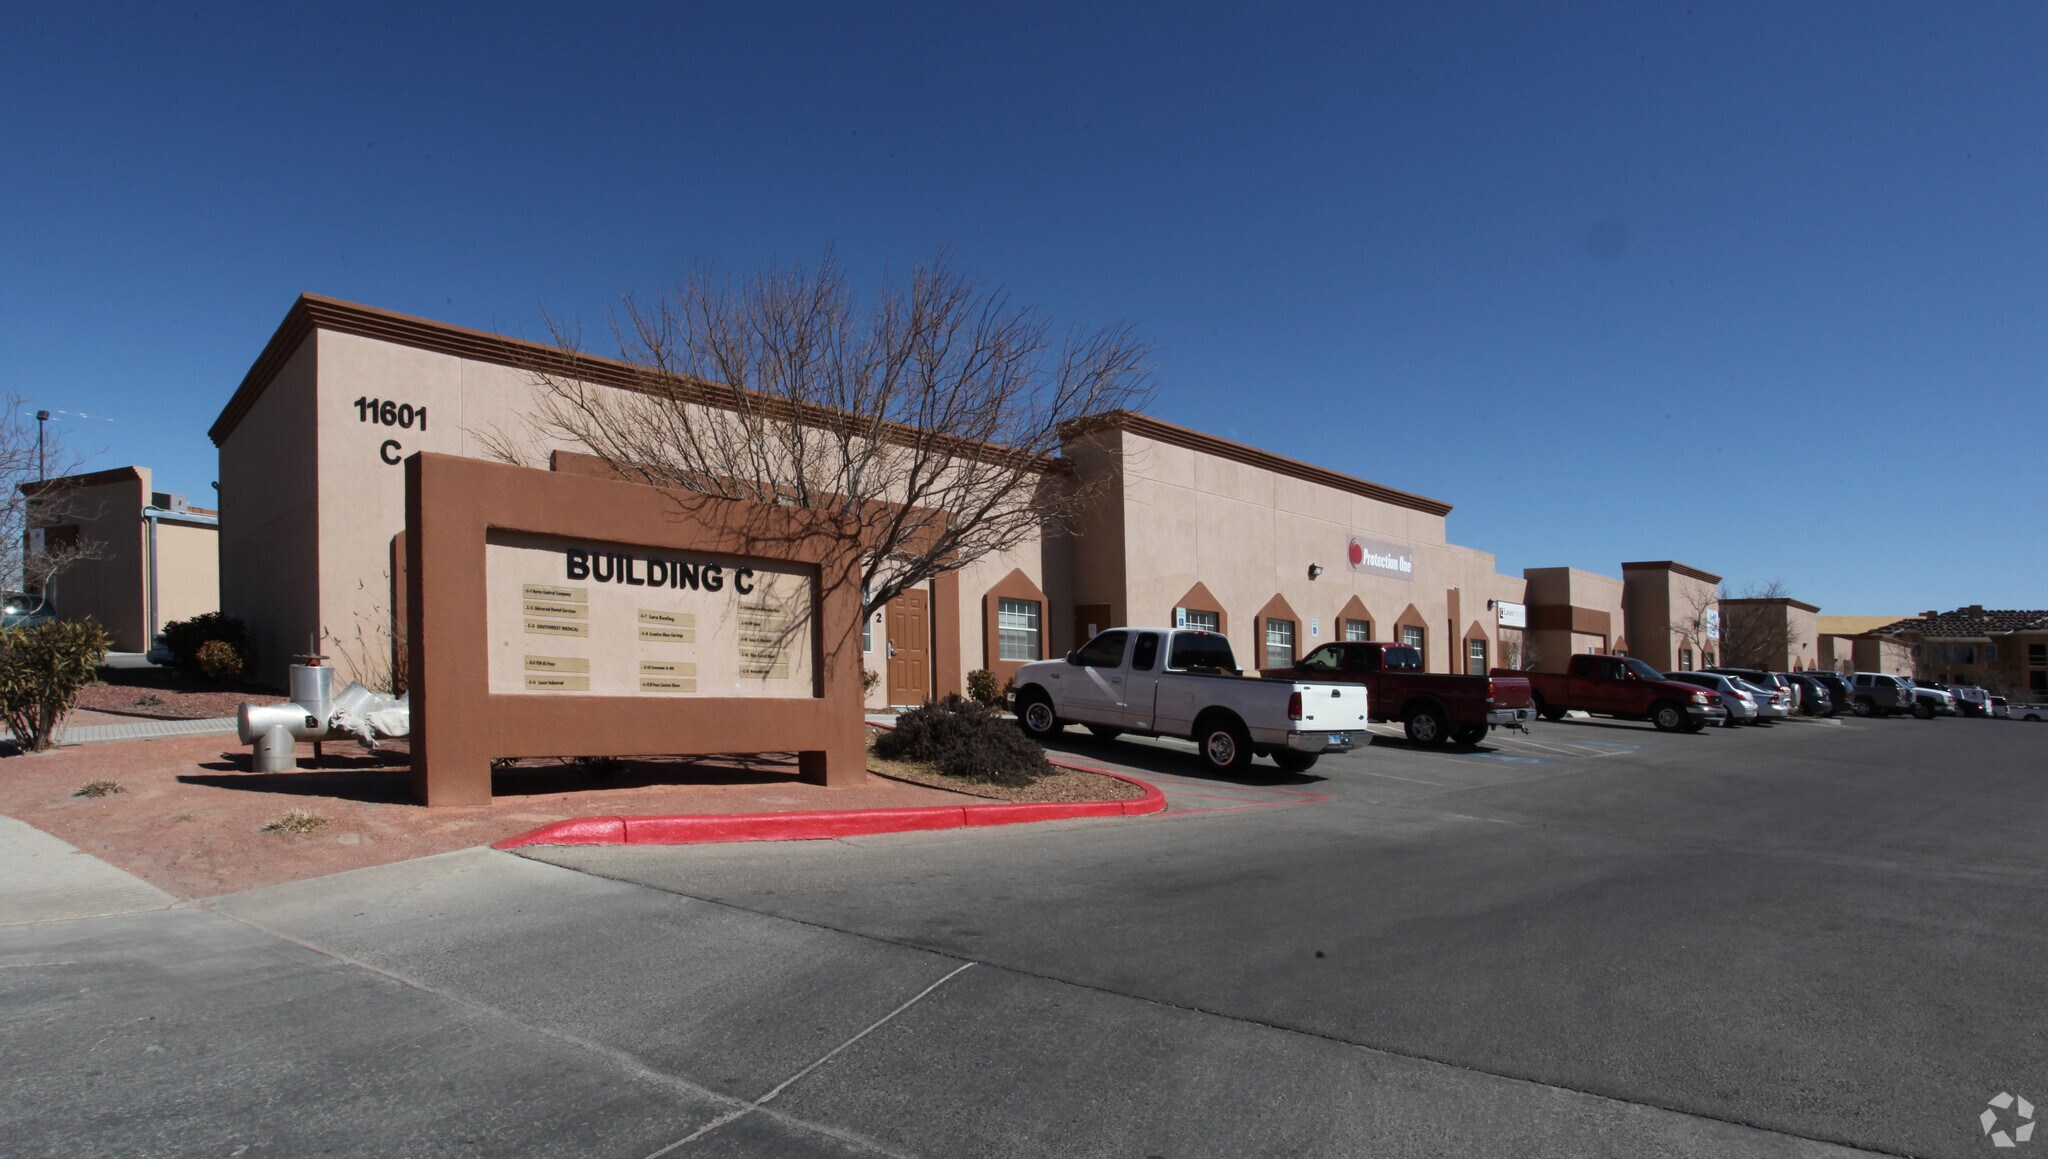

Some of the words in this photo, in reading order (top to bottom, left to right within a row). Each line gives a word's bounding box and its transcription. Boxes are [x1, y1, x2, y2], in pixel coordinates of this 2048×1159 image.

[354, 396, 427, 432] 11601
[380, 439, 402, 466] C
[567, 548, 724, 593] BUILDING
[734, 566, 754, 595] C
[1363, 548, 1398, 571] Protection
[1399, 555, 1412, 573] One
[876, 613, 882, 623] 2
